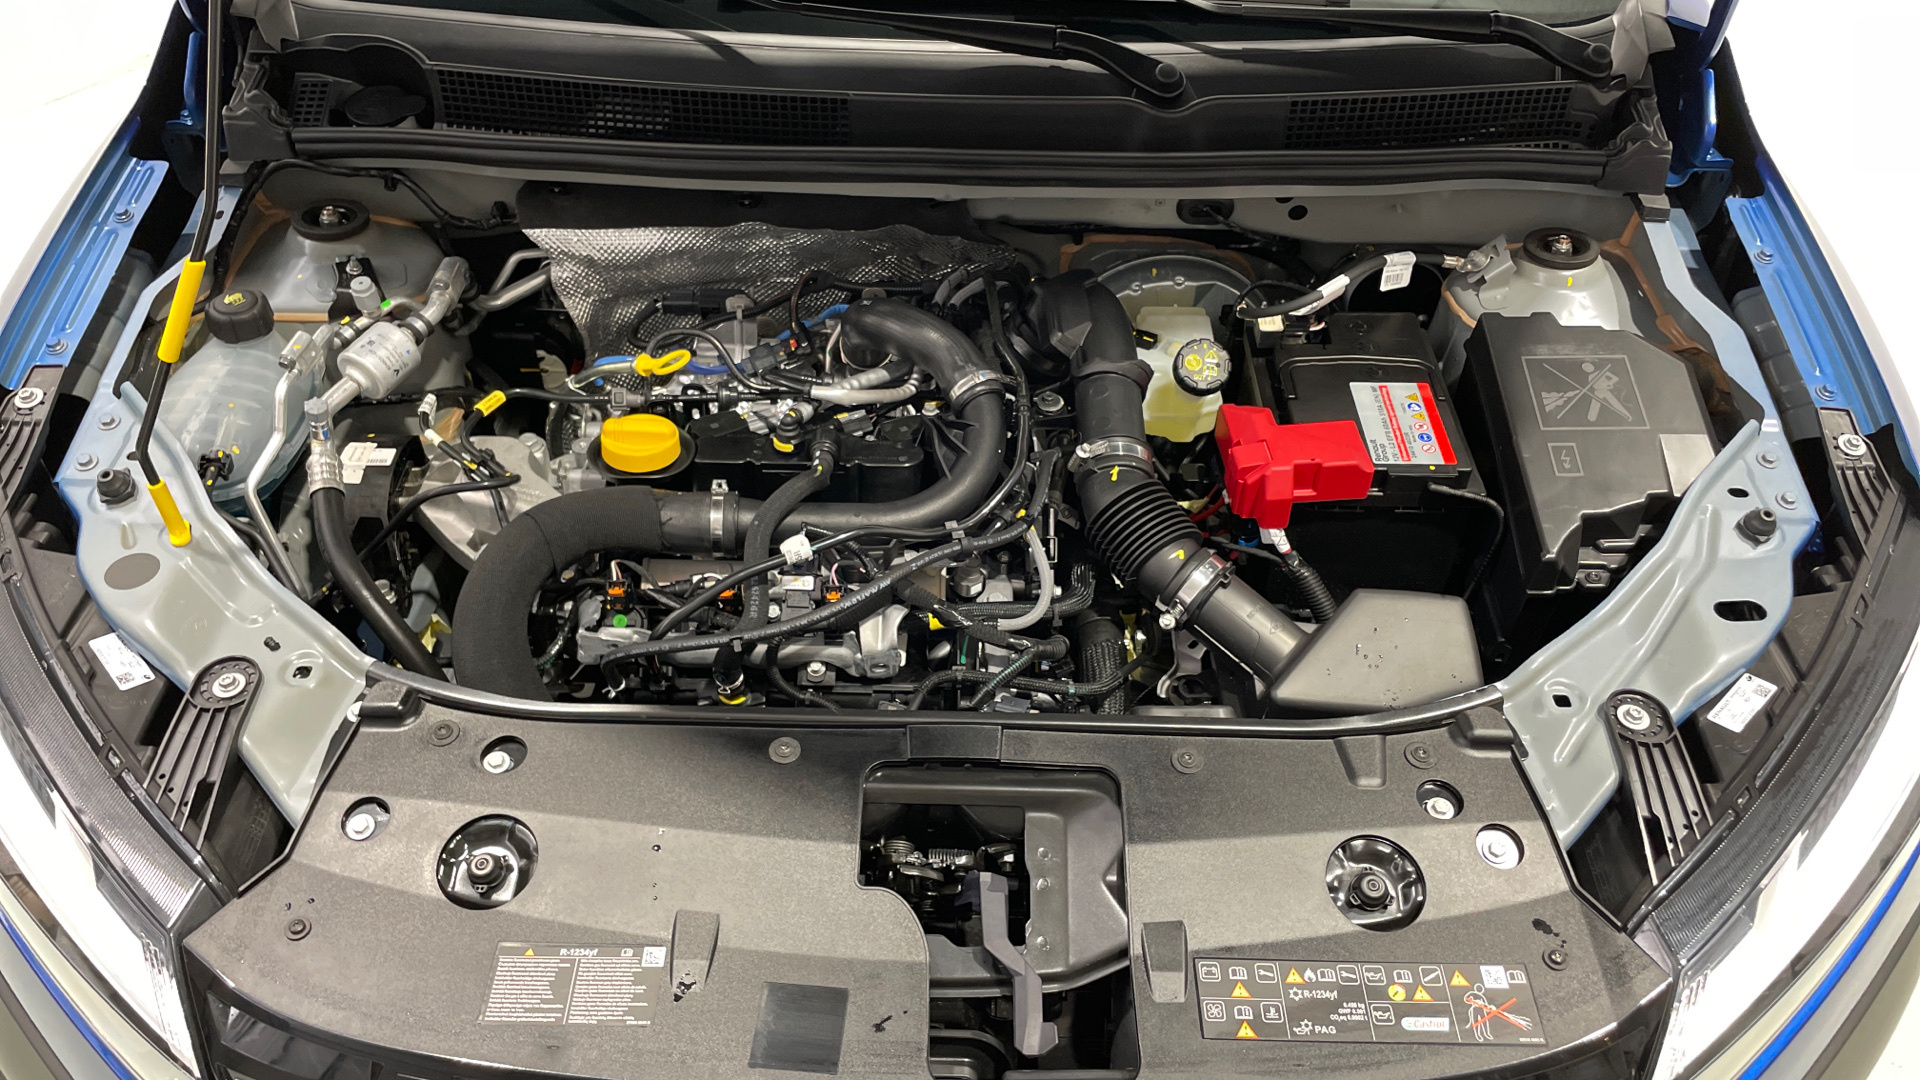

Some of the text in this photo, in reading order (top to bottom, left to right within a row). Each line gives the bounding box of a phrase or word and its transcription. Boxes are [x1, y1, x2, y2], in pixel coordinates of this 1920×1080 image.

[1370, 439, 1382, 462] Renault
[1379, 443, 1390, 462] Group
[1711, 699, 1730, 719] RENAULT
[560, 948, 598, 958] R-1234yf
[1303, 990, 1338, 1000] R-1234yf
[1414, 1020, 1445, 1028] Castrol
[1314, 1025, 1336, 1034] PAG
